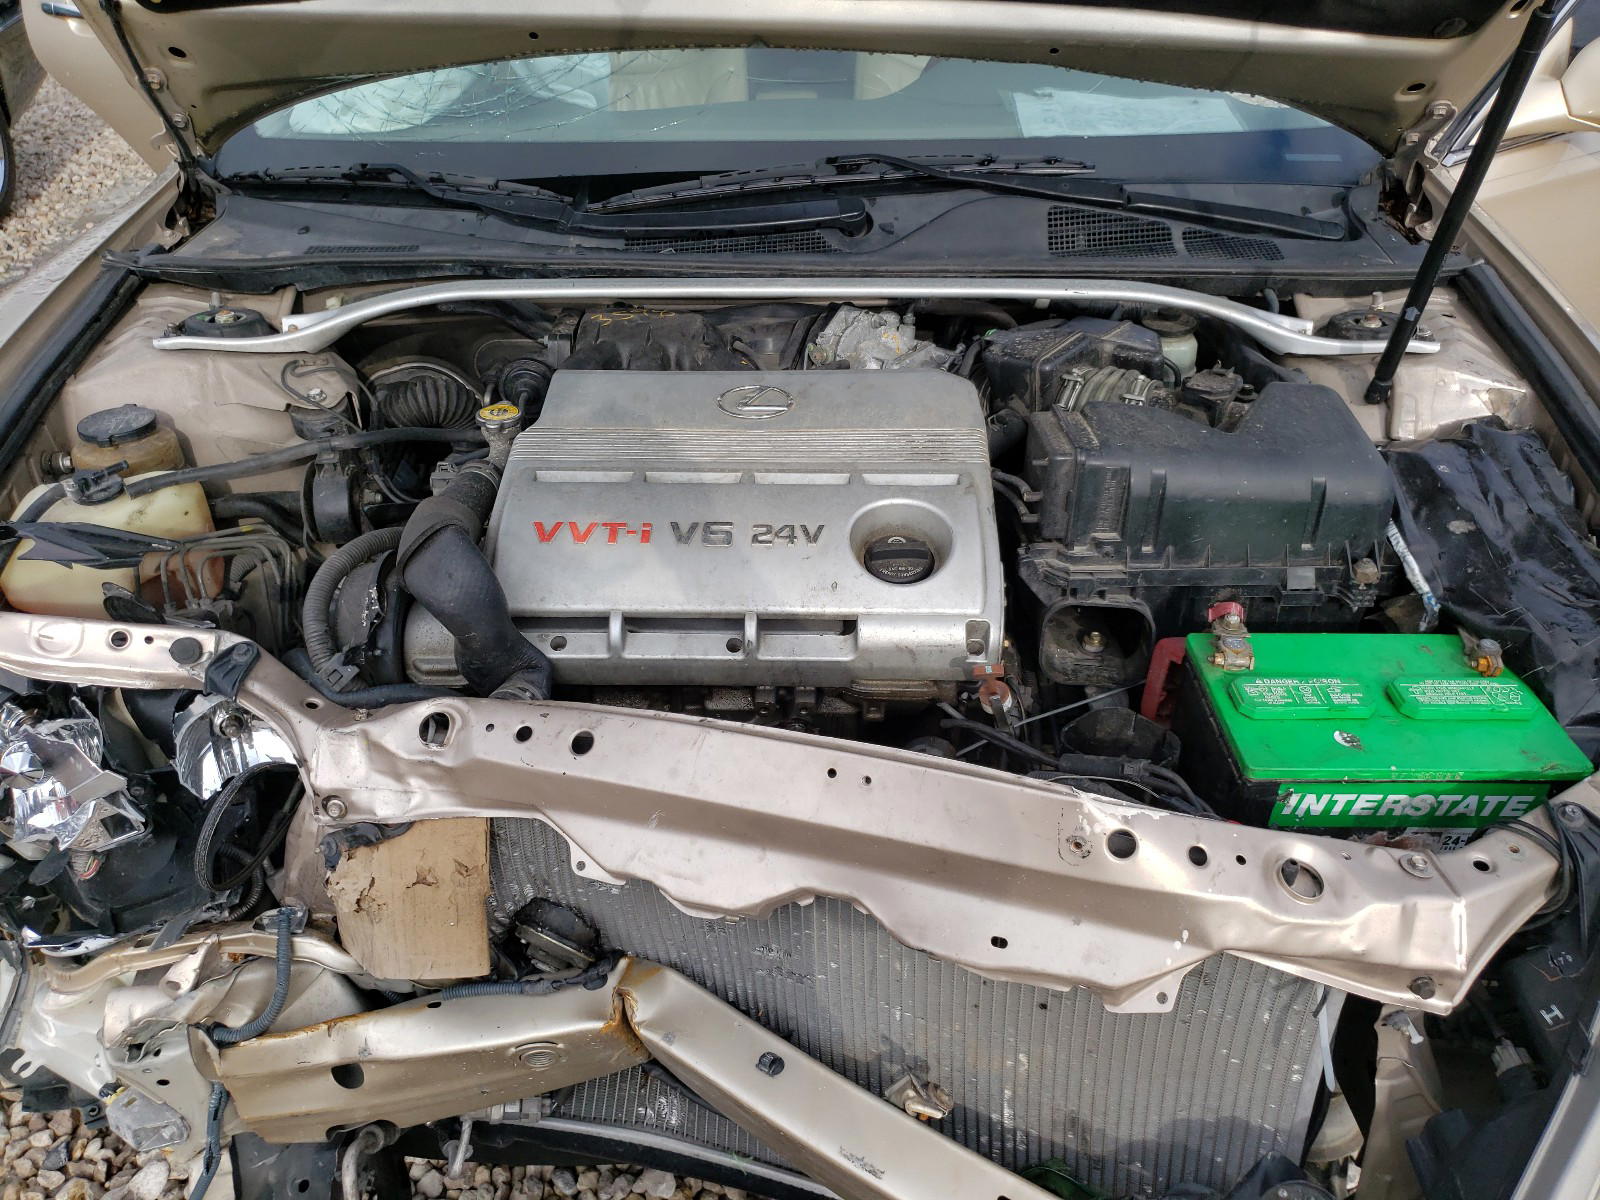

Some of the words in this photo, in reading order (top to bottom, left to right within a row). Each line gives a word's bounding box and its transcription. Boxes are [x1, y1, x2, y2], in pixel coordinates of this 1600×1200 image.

[533, 521, 653, 545] VVT-i
[670, 521, 734, 547] V6
[751, 523, 826, 547] 24V
[1280, 793, 1536, 818] INTERSTATE
